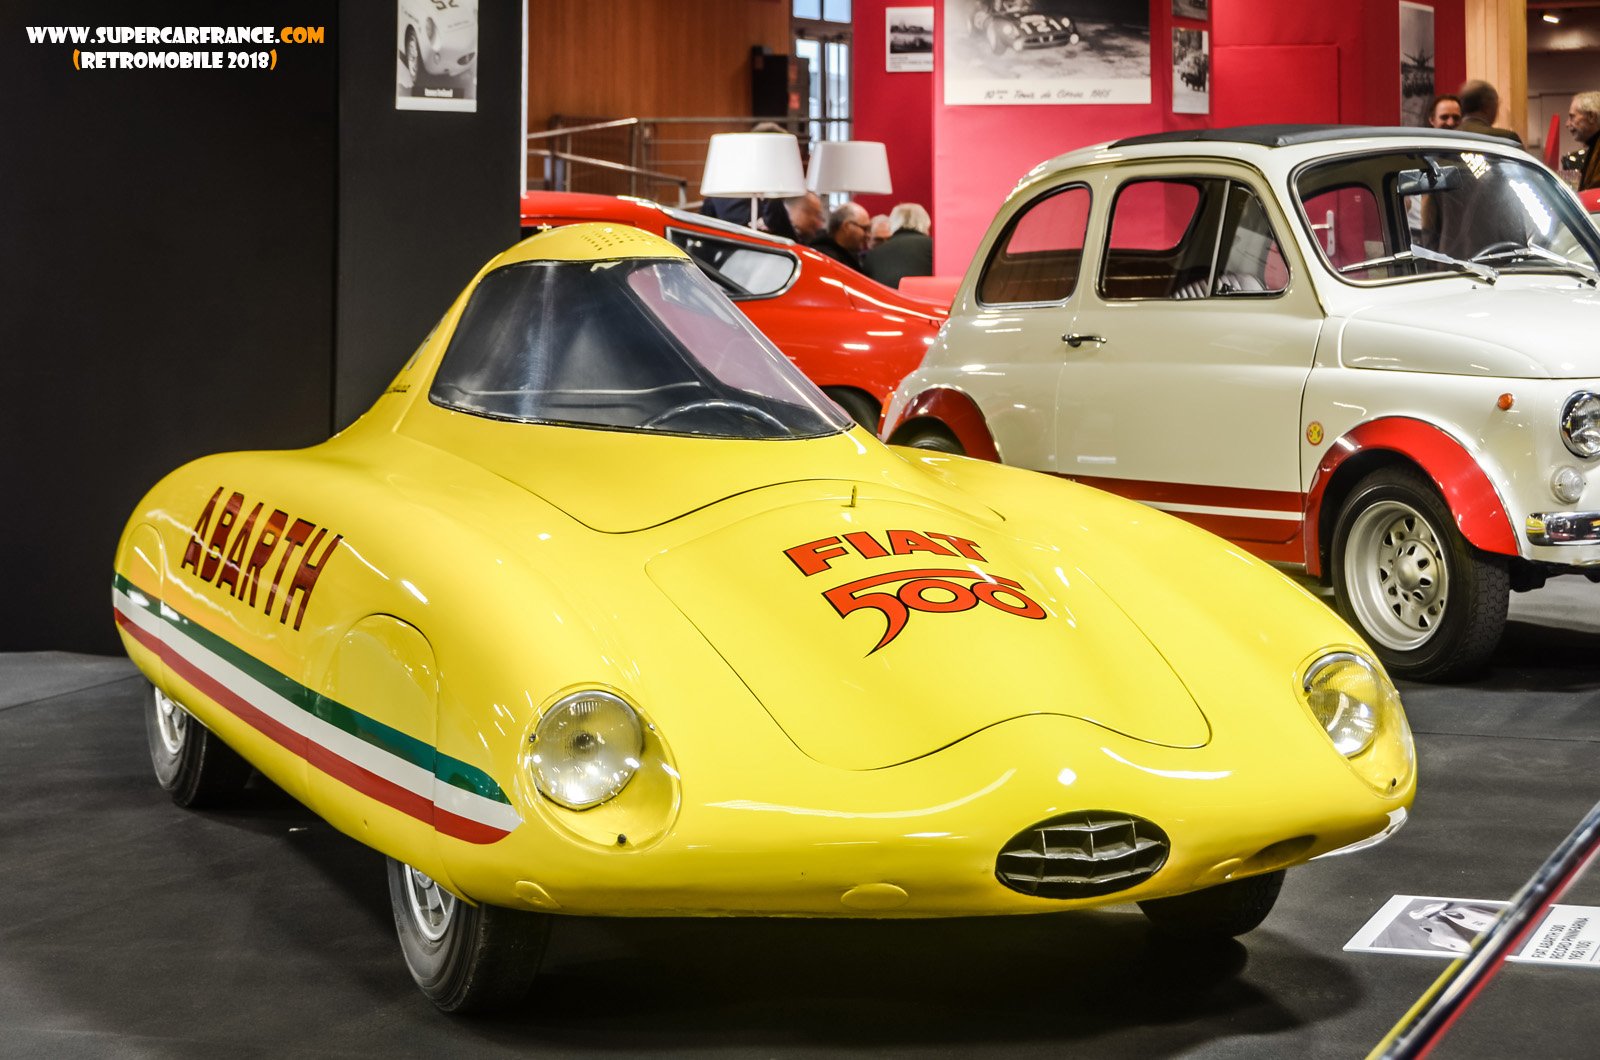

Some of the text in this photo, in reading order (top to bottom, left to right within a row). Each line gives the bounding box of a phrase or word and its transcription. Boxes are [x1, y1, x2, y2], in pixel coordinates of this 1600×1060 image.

[181, 486, 344, 632] ABARTH
[782, 529, 988, 577] FIAT
[821, 568, 1047, 658] 500
